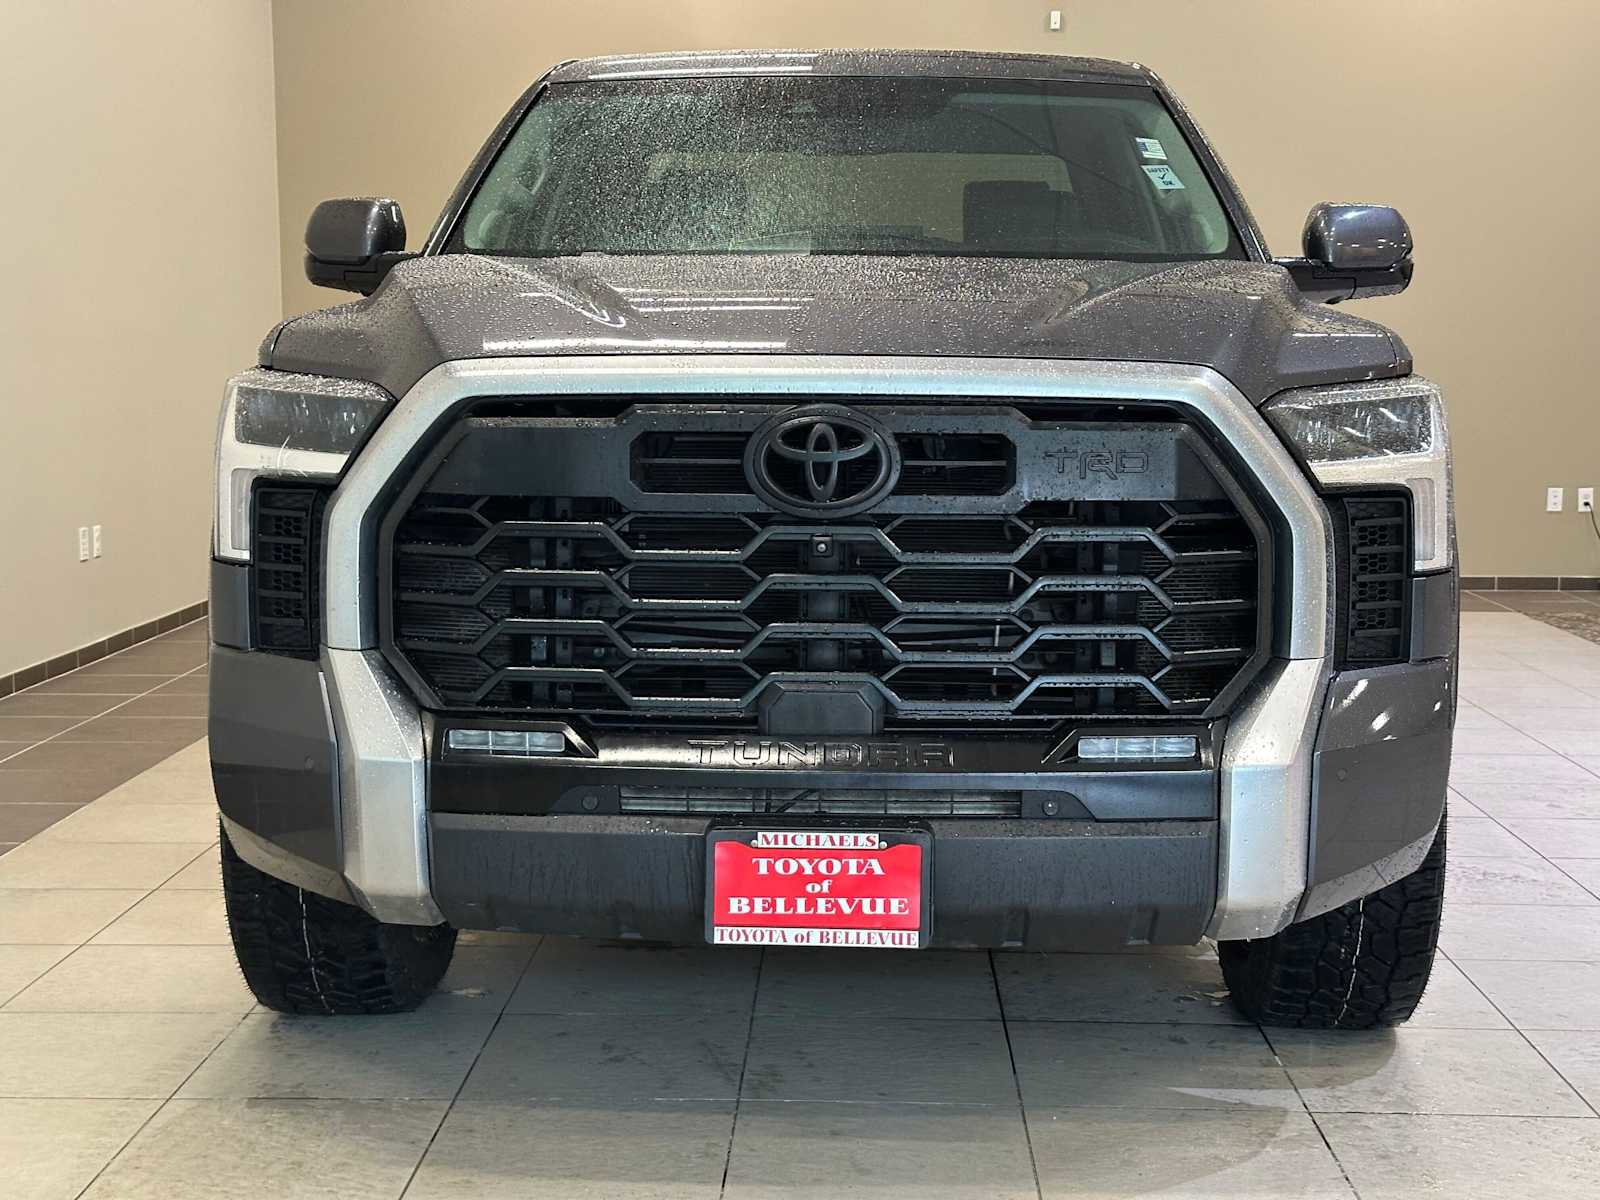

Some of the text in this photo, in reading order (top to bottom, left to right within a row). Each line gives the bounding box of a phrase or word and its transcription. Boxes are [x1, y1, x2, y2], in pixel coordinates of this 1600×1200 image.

[1043, 451, 1149, 480] TRD
[687, 739, 955, 768] TUNDRA
[760, 833, 877, 848] MICHAELS
[752, 857, 885, 876] TOYOTA
[805, 879, 832, 894] of
[728, 896, 910, 915] BELLEVUE
[716, 928, 918, 947] TOYOTA of BELLEVUE
